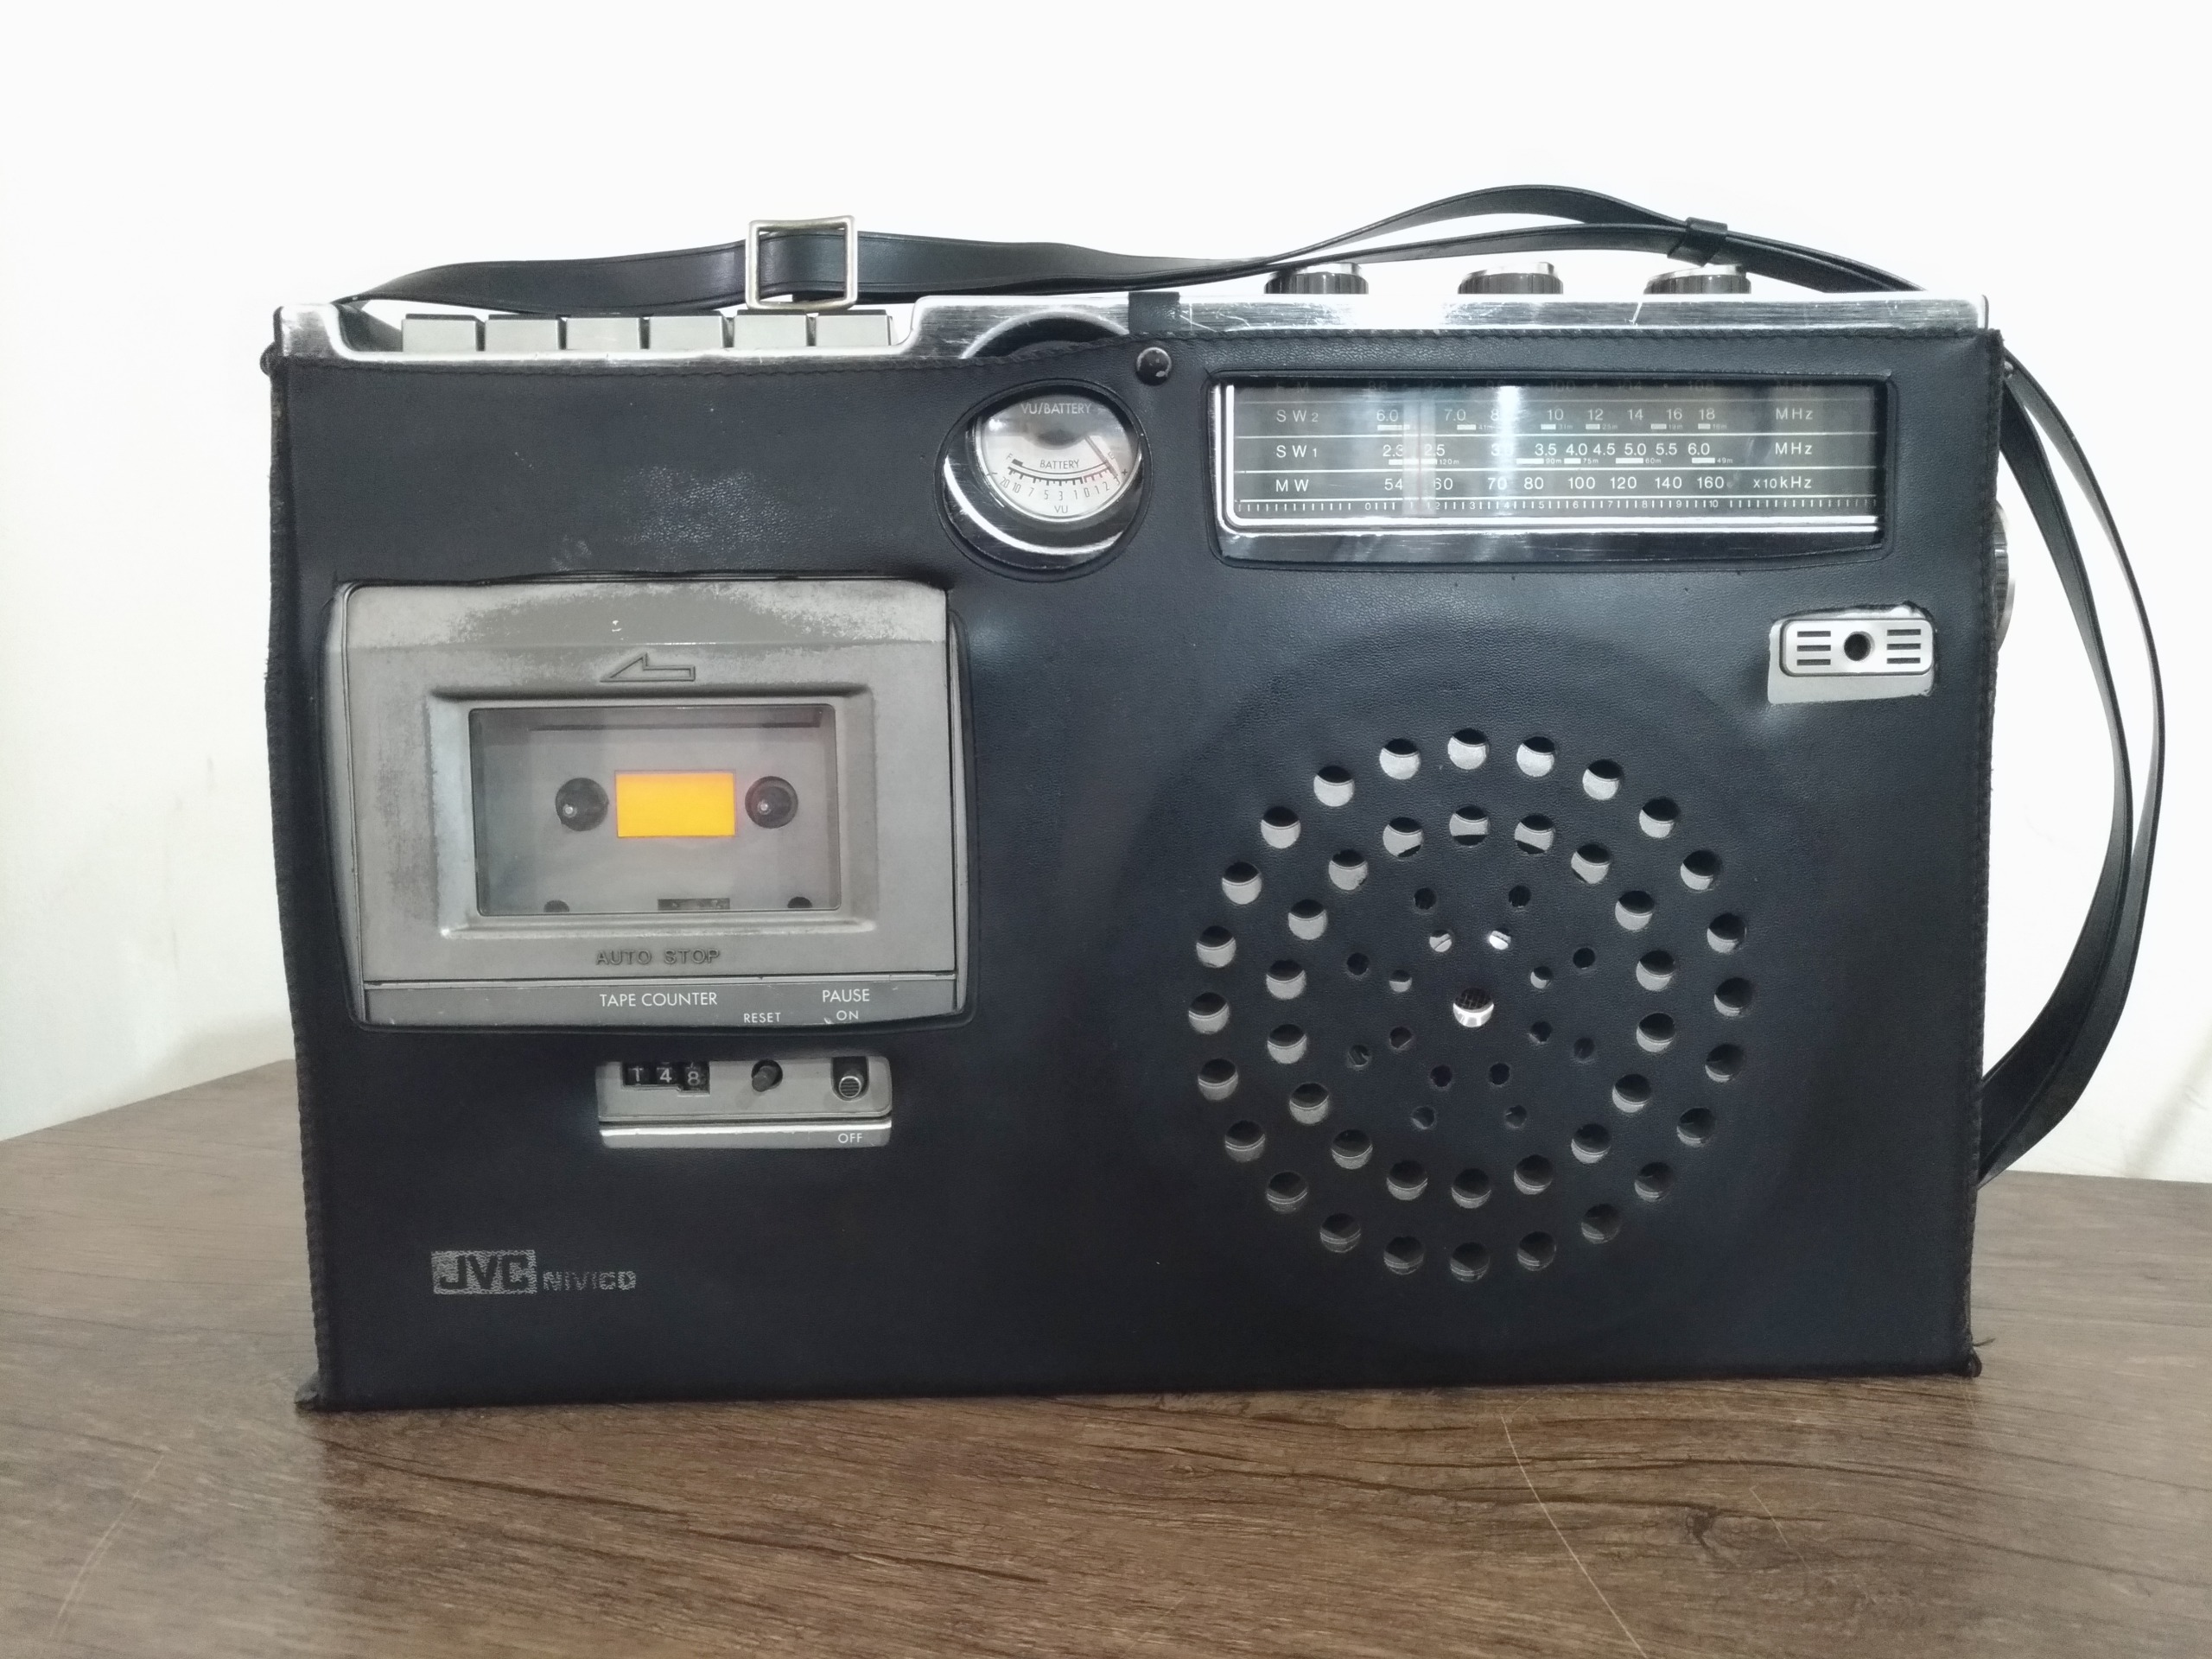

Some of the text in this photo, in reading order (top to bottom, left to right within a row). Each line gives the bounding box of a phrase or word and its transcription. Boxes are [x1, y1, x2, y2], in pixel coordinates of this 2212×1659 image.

[1020, 403, 1092, 415] VU/BATTERY
[1376, 409, 1399, 422] 6.0
[1445, 409, 1466, 422] 7.0
[1547, 408, 1564, 421] 10
[1586, 408, 1604, 421] 12
[1627, 408, 1643, 421] 14
[1666, 407, 1682, 420] 16
[1698, 407, 1715, 420] 18
[1776, 407, 1814, 420] MHz
[1382, 444, 1403, 457] 2.3
[1424, 443, 1446, 457] 2.5
[1534, 443, 1557, 456] 3.5
[1566, 443, 1588, 456] 4.0
[1592, 443, 1616, 456] 4.5
[1624, 442, 1647, 455] 5.0
[1656, 442, 1678, 455] 5.5
[1688, 442, 1711, 455] 6.0
[1775, 442, 1813, 455] MHz
[1039, 459, 1079, 470] BATTERY
[1000, 476, 1010, 489] 20
[1012, 482, 1021, 493] 10
[1028, 487, 1035, 497] 7
[1044, 489, 1049, 500] 5
[1058, 491, 1064, 500] 3
[1073, 489, 1078, 499] 1
[1084, 487, 1090, 498] 0
[1095, 485, 1100, 494] 1
[1102, 481, 1109, 491] 2
[1275, 479, 1309, 493] MW
[1384, 478, 1404, 491] 54
[1433, 477, 1453, 490] 60
[1487, 477, 1508, 490] 70
[1523, 476, 1544, 490] 80
[1567, 476, 1596, 490] 100
[1610, 476, 1637, 490] 120
[1655, 476, 1682, 489] 140
[1696, 476, 1725, 489] 160
[1054, 505, 1069, 514] VU
[595, 948, 721, 966] AUTO STOP
[600, 992, 718, 1007] TAPE COUNTER
[822, 988, 870, 1003] PAUSE
[743, 1012, 781, 1024] RESET
[836, 1009, 859, 1021] ON
[838, 1133, 863, 1144] OFF
[435, 1253, 533, 1292] JVC
